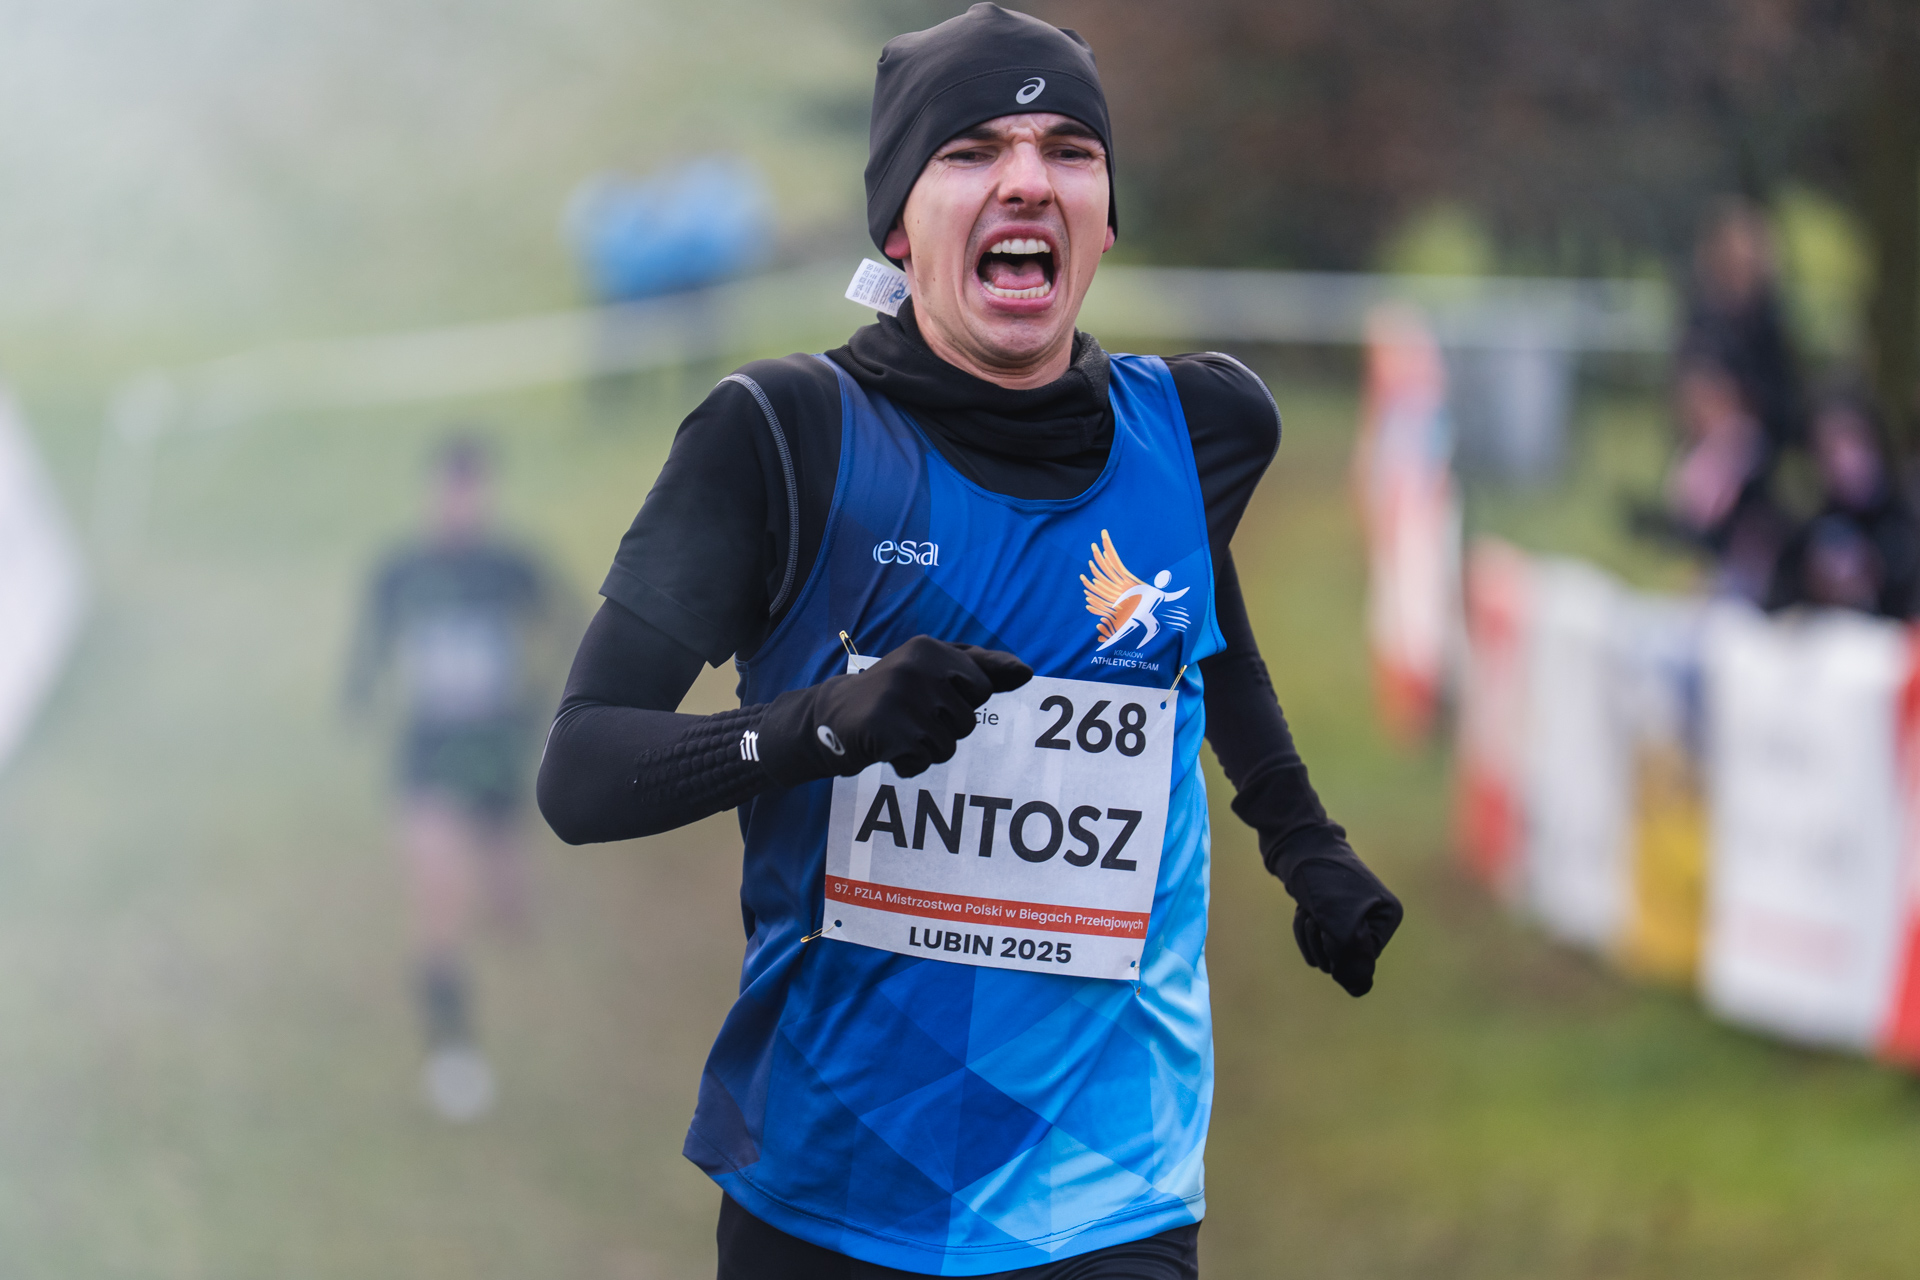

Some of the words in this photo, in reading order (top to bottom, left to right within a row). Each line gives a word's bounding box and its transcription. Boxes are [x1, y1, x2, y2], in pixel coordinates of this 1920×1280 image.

[1090, 656, 1137, 669] ATHLETICS
[1138, 661, 1159, 671] TEAM
[1035, 695, 1147, 757] 268
[855, 784, 1143, 872] ANTOSZ
[834, 882, 851, 896] 97.
[854, 886, 883, 901] PZLA
[886, 892, 962, 913] Mistrzostwa
[965, 903, 1003, 917] Polski
[1005, 909, 1016, 918] w
[1019, 908, 1072, 924] Biegach
[1075, 914, 1144, 932] Przełajowych
[909, 926, 994, 956] LUBIN
[1000, 937, 1072, 964] 2025
